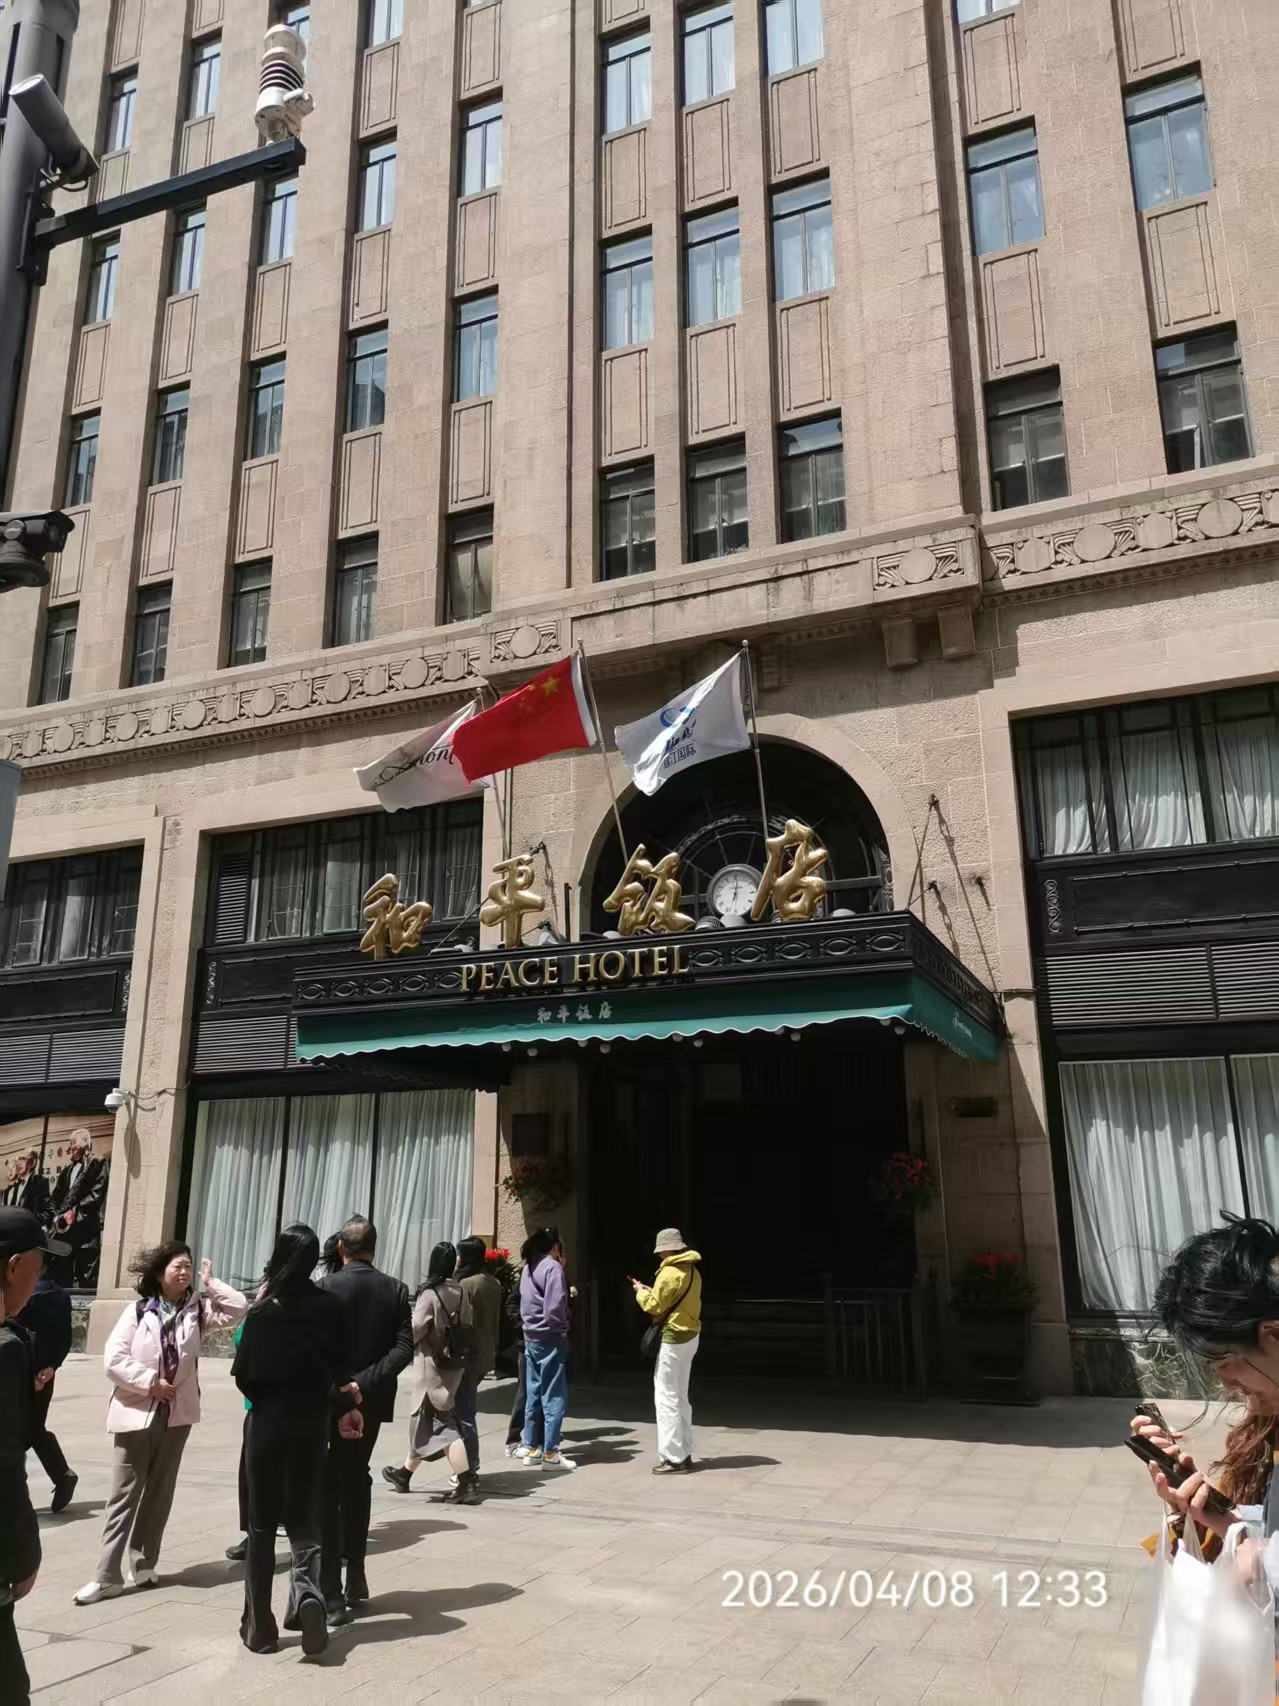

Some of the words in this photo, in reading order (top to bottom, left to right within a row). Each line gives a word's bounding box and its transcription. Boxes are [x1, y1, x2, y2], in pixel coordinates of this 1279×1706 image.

[360, 819, 829, 959] 和平饭店
[459, 956, 559, 993] PEACE
[572, 945, 691, 983] HOTEL
[536, 1001, 612, 1024] 和平饭店
